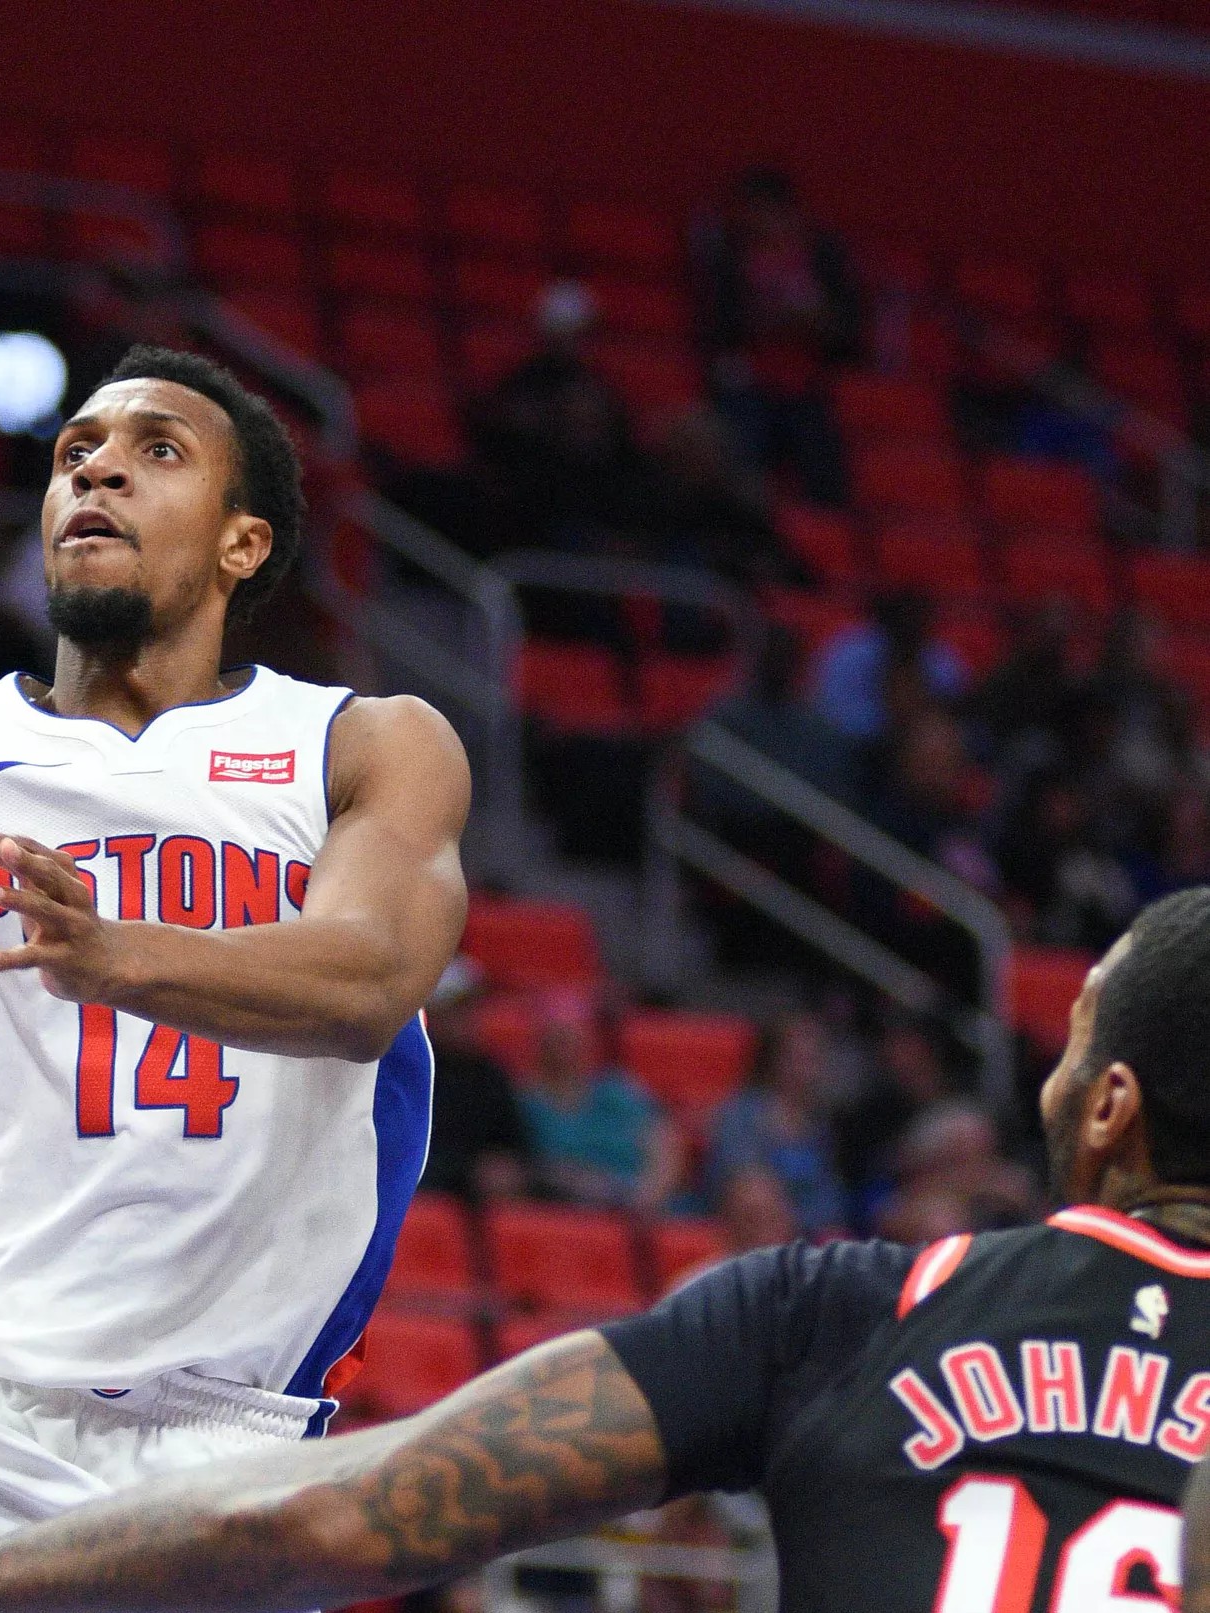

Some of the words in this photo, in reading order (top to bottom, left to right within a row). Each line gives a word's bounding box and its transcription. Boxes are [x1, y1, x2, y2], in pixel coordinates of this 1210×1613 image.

[214, 755, 291, 772] Flagstar
[76, 1003, 240, 1139] 14
[890, 1341, 1210, 1469] JOHNS
